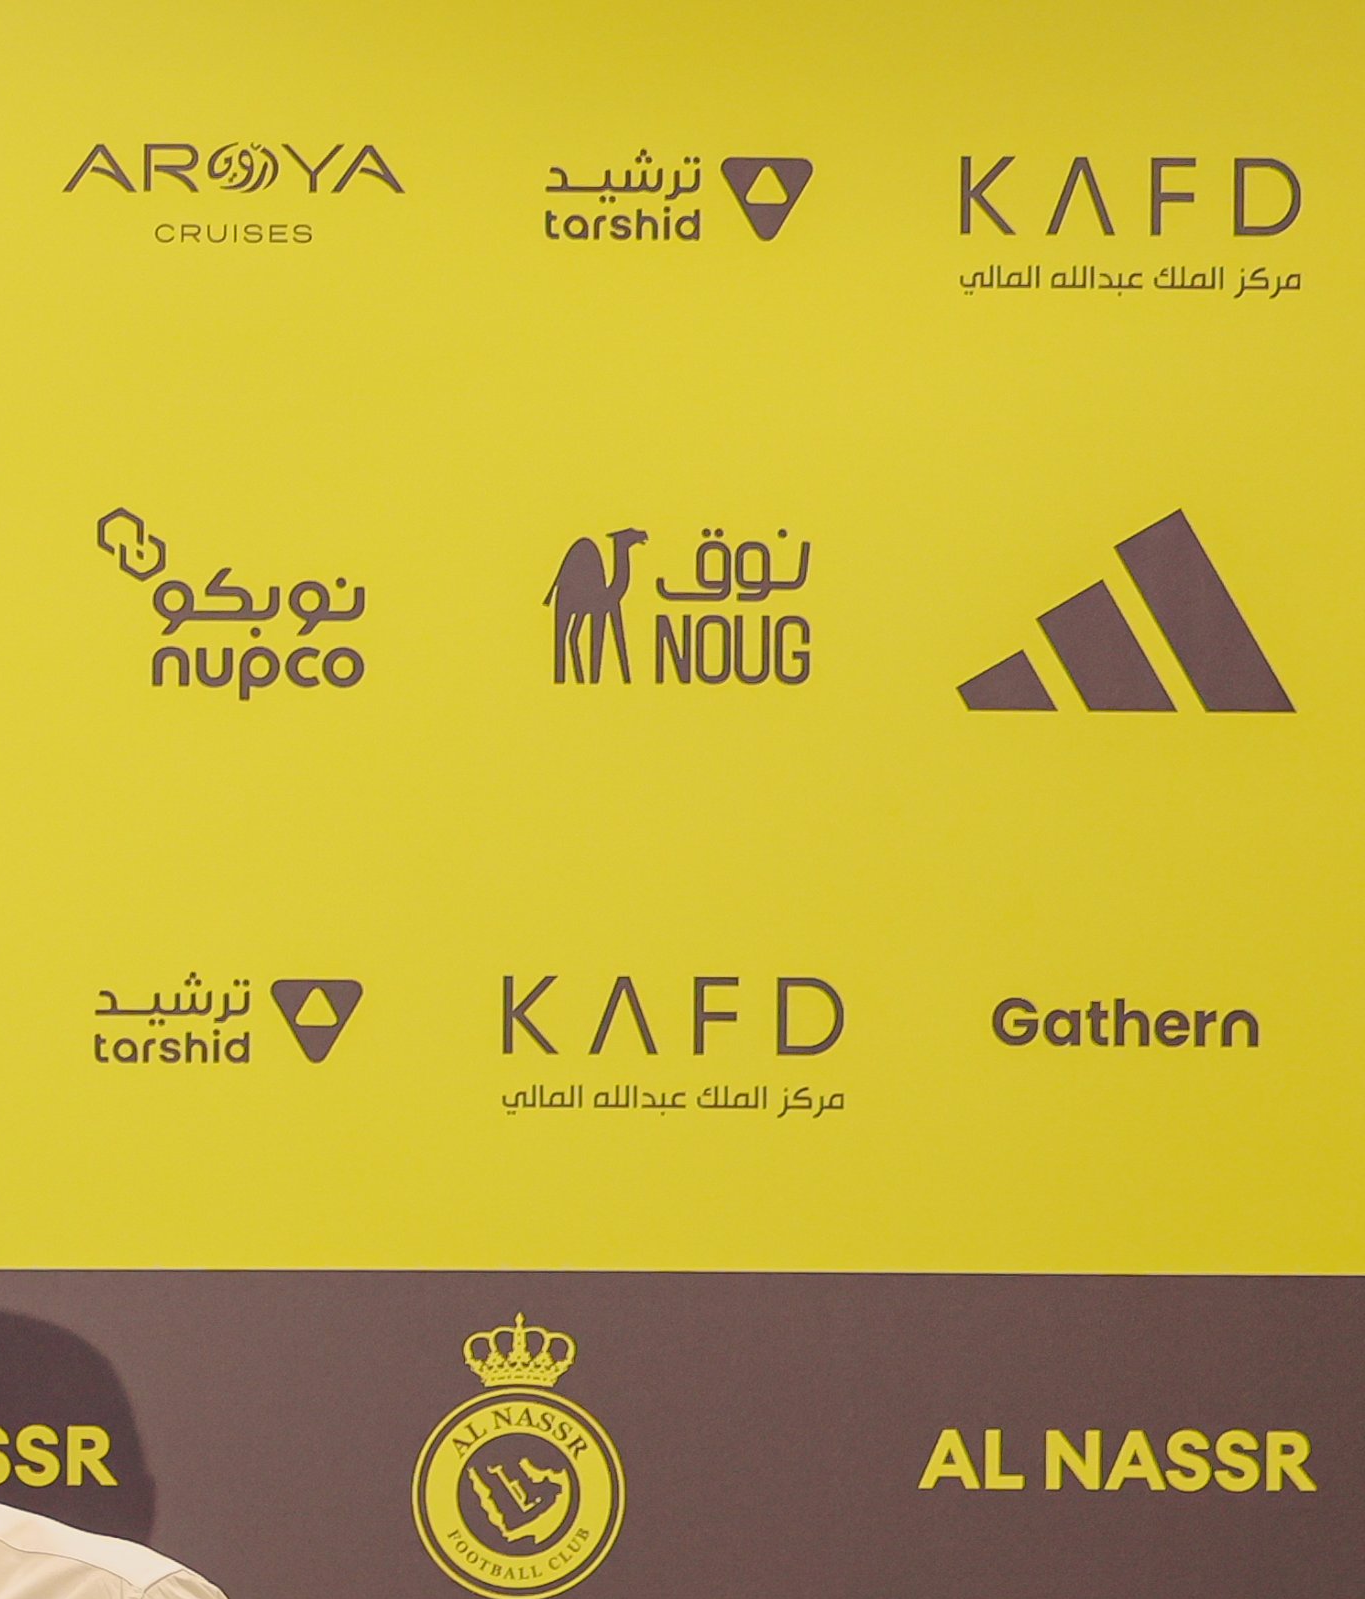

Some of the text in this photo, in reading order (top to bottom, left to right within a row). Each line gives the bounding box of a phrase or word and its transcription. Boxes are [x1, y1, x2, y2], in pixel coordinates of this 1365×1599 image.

[545, 148, 701, 204] ترشيد
[960, 155, 1302, 237] KAFD
[154, 223, 313, 244] CRUISES
[544, 205, 701, 241] tarshid
[959, 264, 1302, 300] مركز الملك عبدالله المالي
[655, 527, 811, 602] نوق
[151, 567, 366, 638] نوبكو
[151, 645, 365, 701] nupco
[655, 614, 811, 686] NOUG
[94, 971, 251, 1027] ترشيد
[502, 975, 845, 1056] KAFD
[991, 997, 1260, 1048] Gathern
[94, 1028, 250, 1064] tarshid
[501, 1084, 845, 1119] مركز الملك عبدالله المالي
[451, 1407, 589, 1460] AL NASSR
[918, 1428, 1317, 1492] AL NASSR
[447, 1528, 590, 1580] FOOTBALL CLUB
